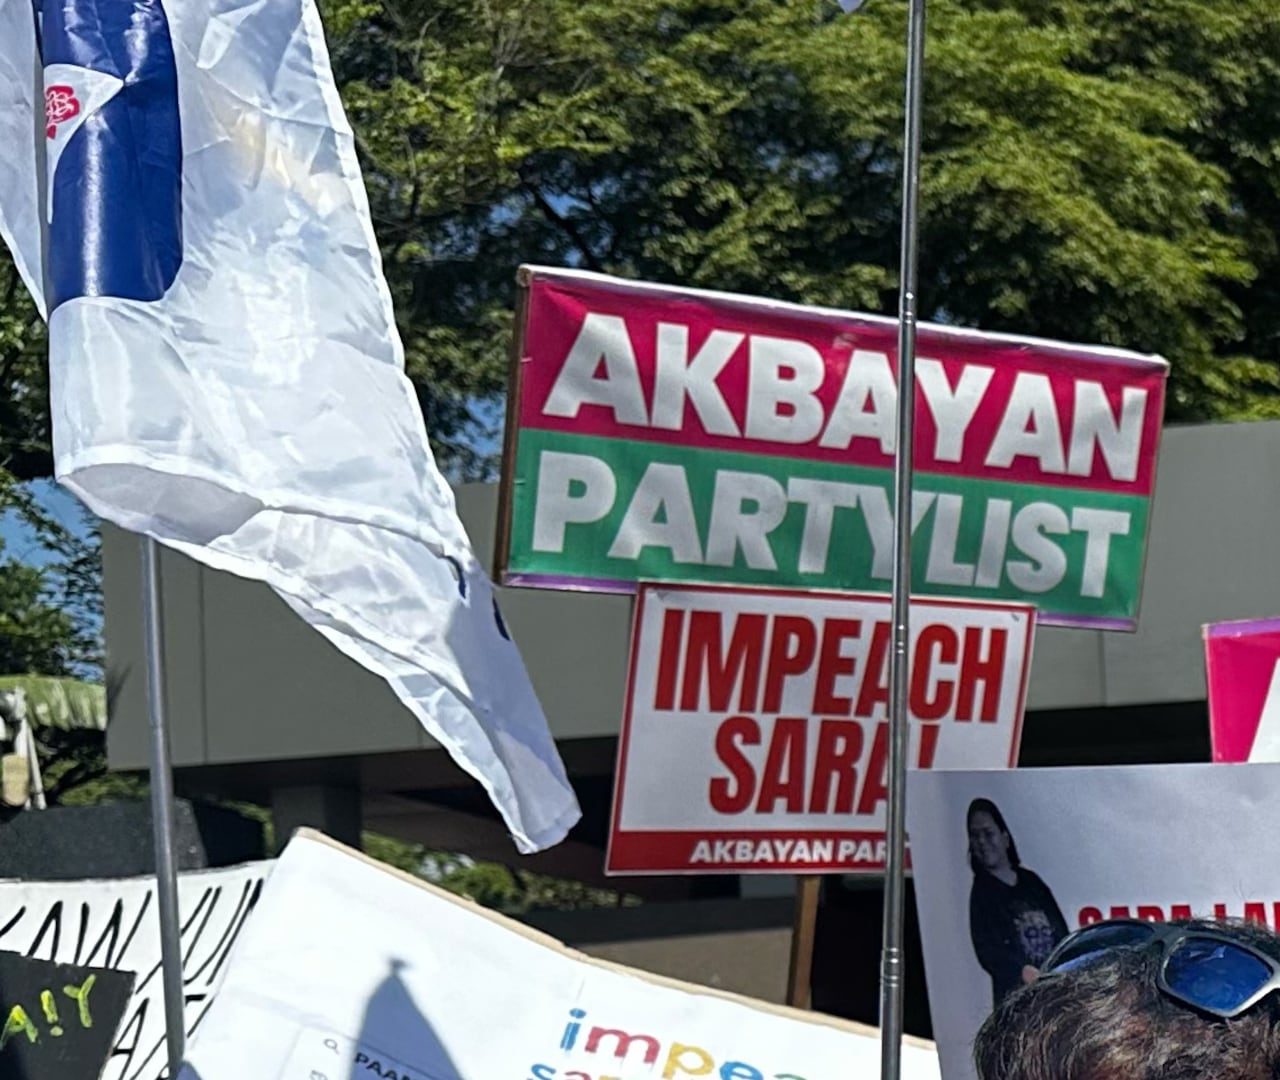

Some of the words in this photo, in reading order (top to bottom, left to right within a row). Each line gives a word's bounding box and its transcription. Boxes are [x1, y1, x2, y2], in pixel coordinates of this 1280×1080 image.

[542, 312, 1149, 482] AKBAYAN
[531, 450, 1131, 599] PARTYLIST
[654, 608, 1009, 723] IMPEACH
[689, 839, 834, 864] AKBAYAN
